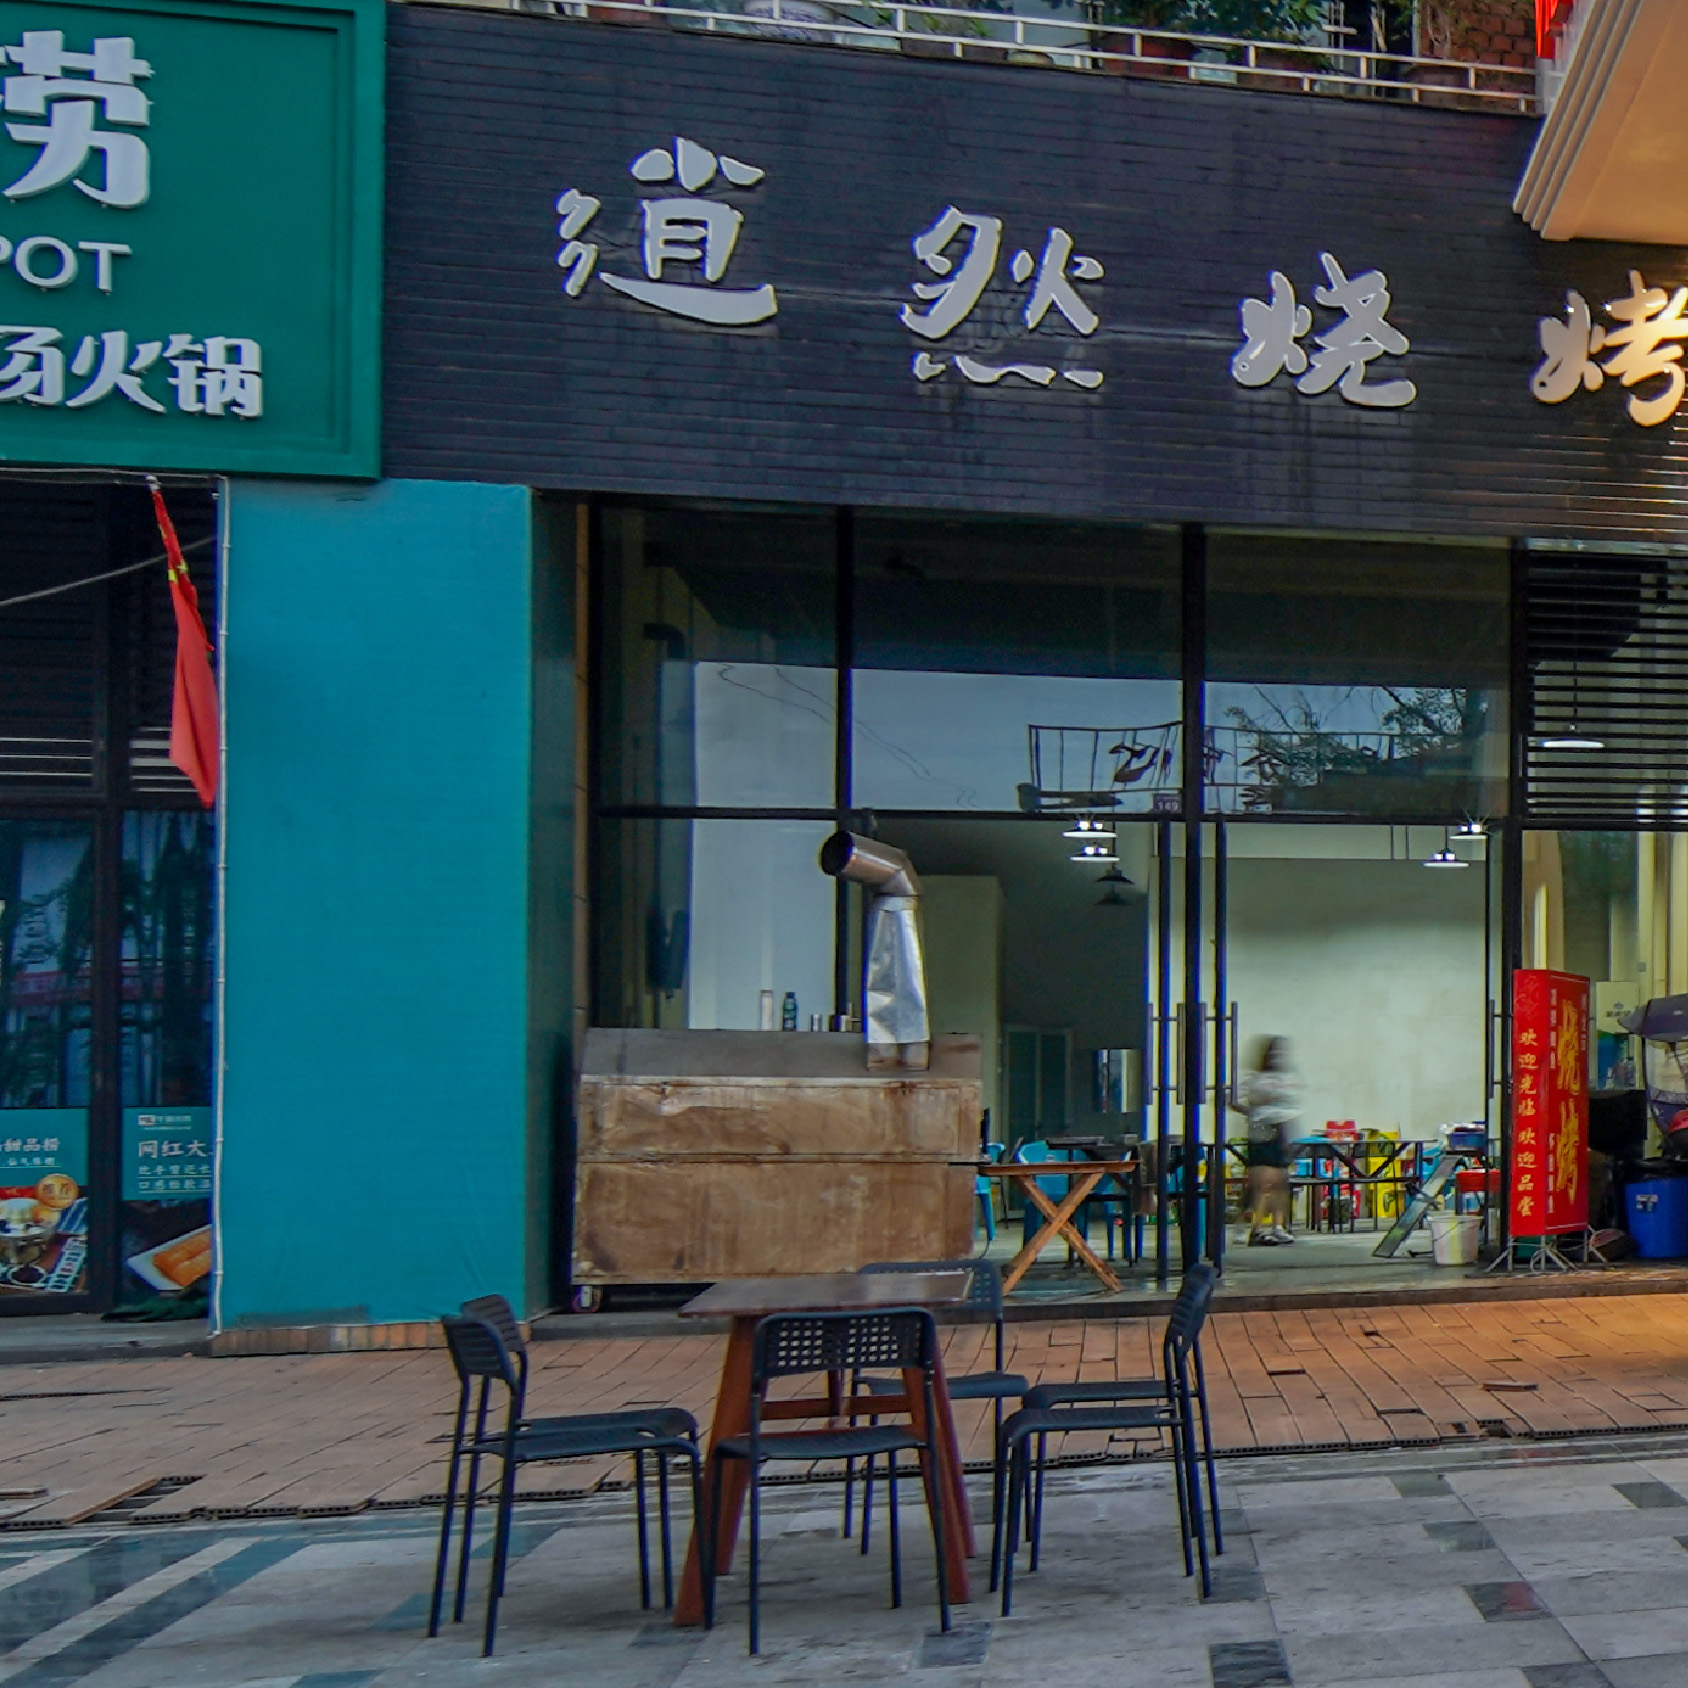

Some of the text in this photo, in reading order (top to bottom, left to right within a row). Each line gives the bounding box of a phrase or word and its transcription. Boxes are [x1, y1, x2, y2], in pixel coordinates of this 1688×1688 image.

[0, 30, 155, 208] 劳
[138, 1139, 212, 1159] 网红大
